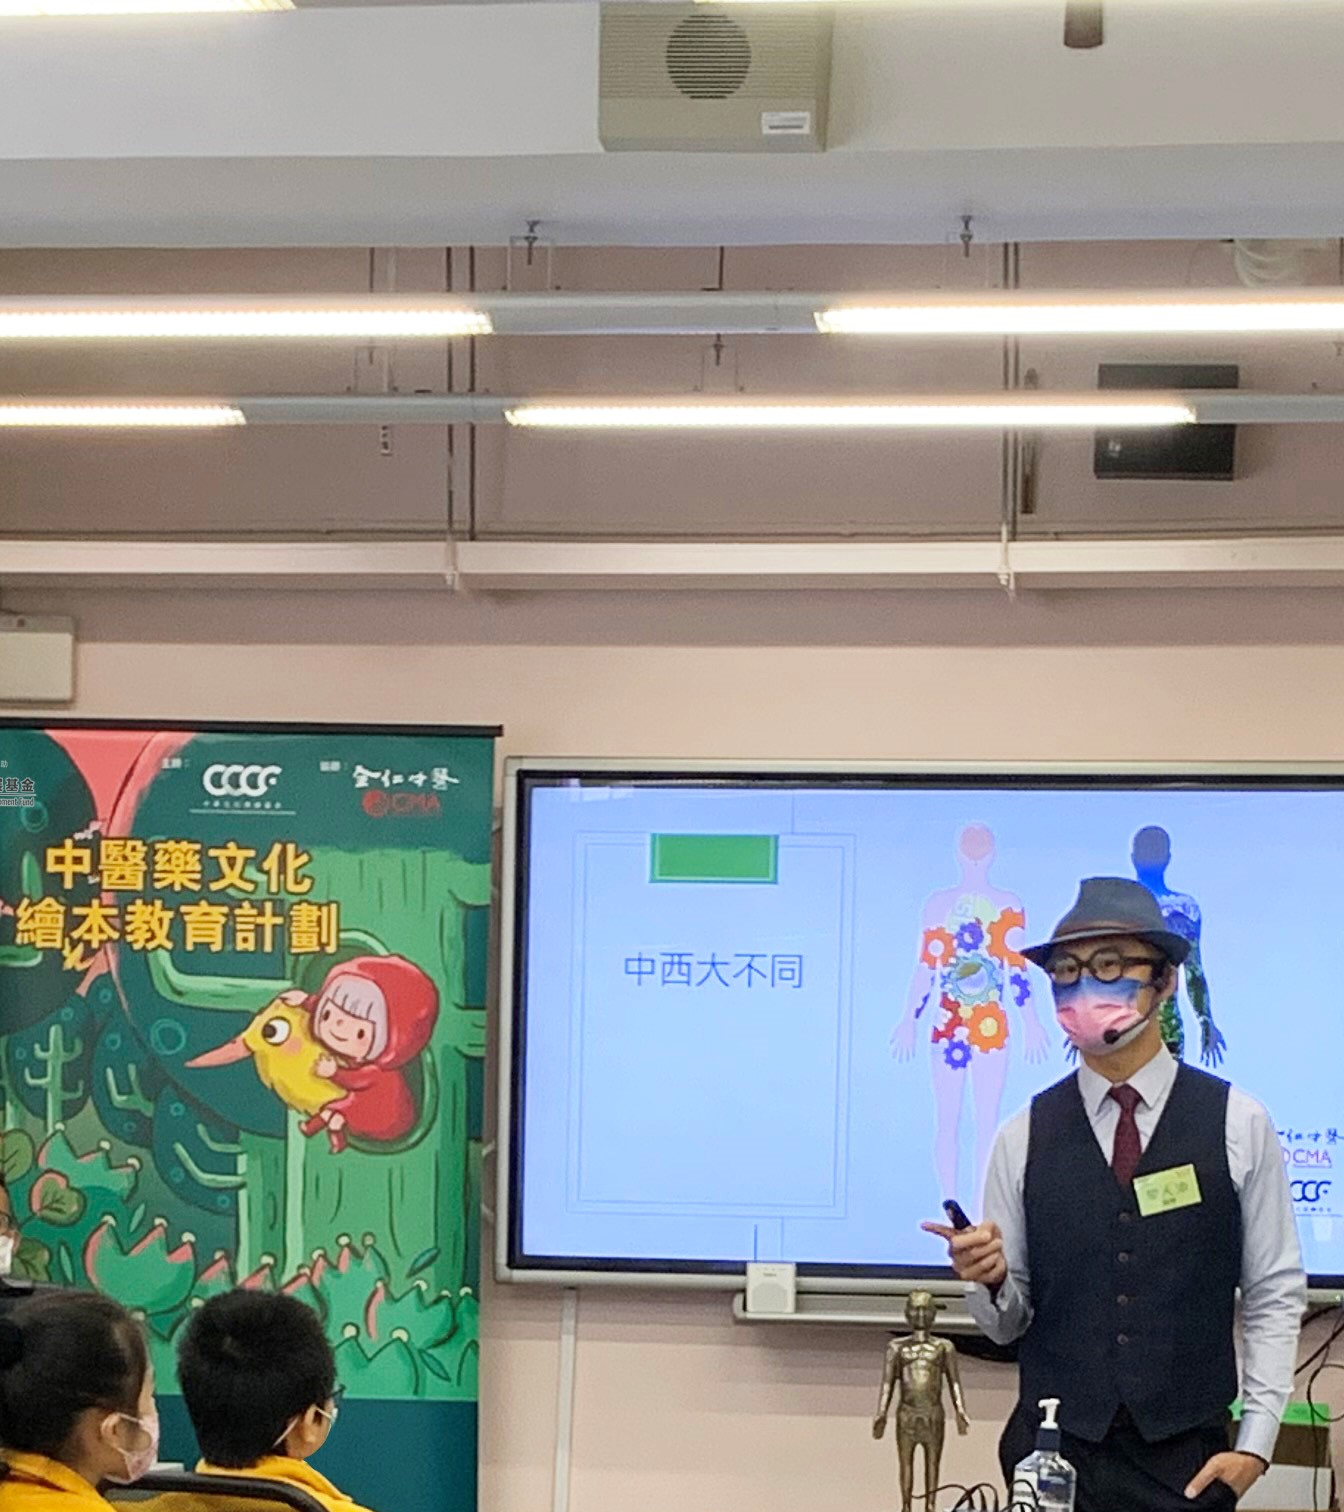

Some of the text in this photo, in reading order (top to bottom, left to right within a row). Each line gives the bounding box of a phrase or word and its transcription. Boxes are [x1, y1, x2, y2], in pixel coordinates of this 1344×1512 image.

[19, 797, 35, 807] Fund
[45, 838, 313, 893] 中醫藥文化
[14, 896, 340, 955] 繪本教育計劃
[624, 951, 803, 989] 中西大不同
[1292, 1149, 1332, 1164] CMA
